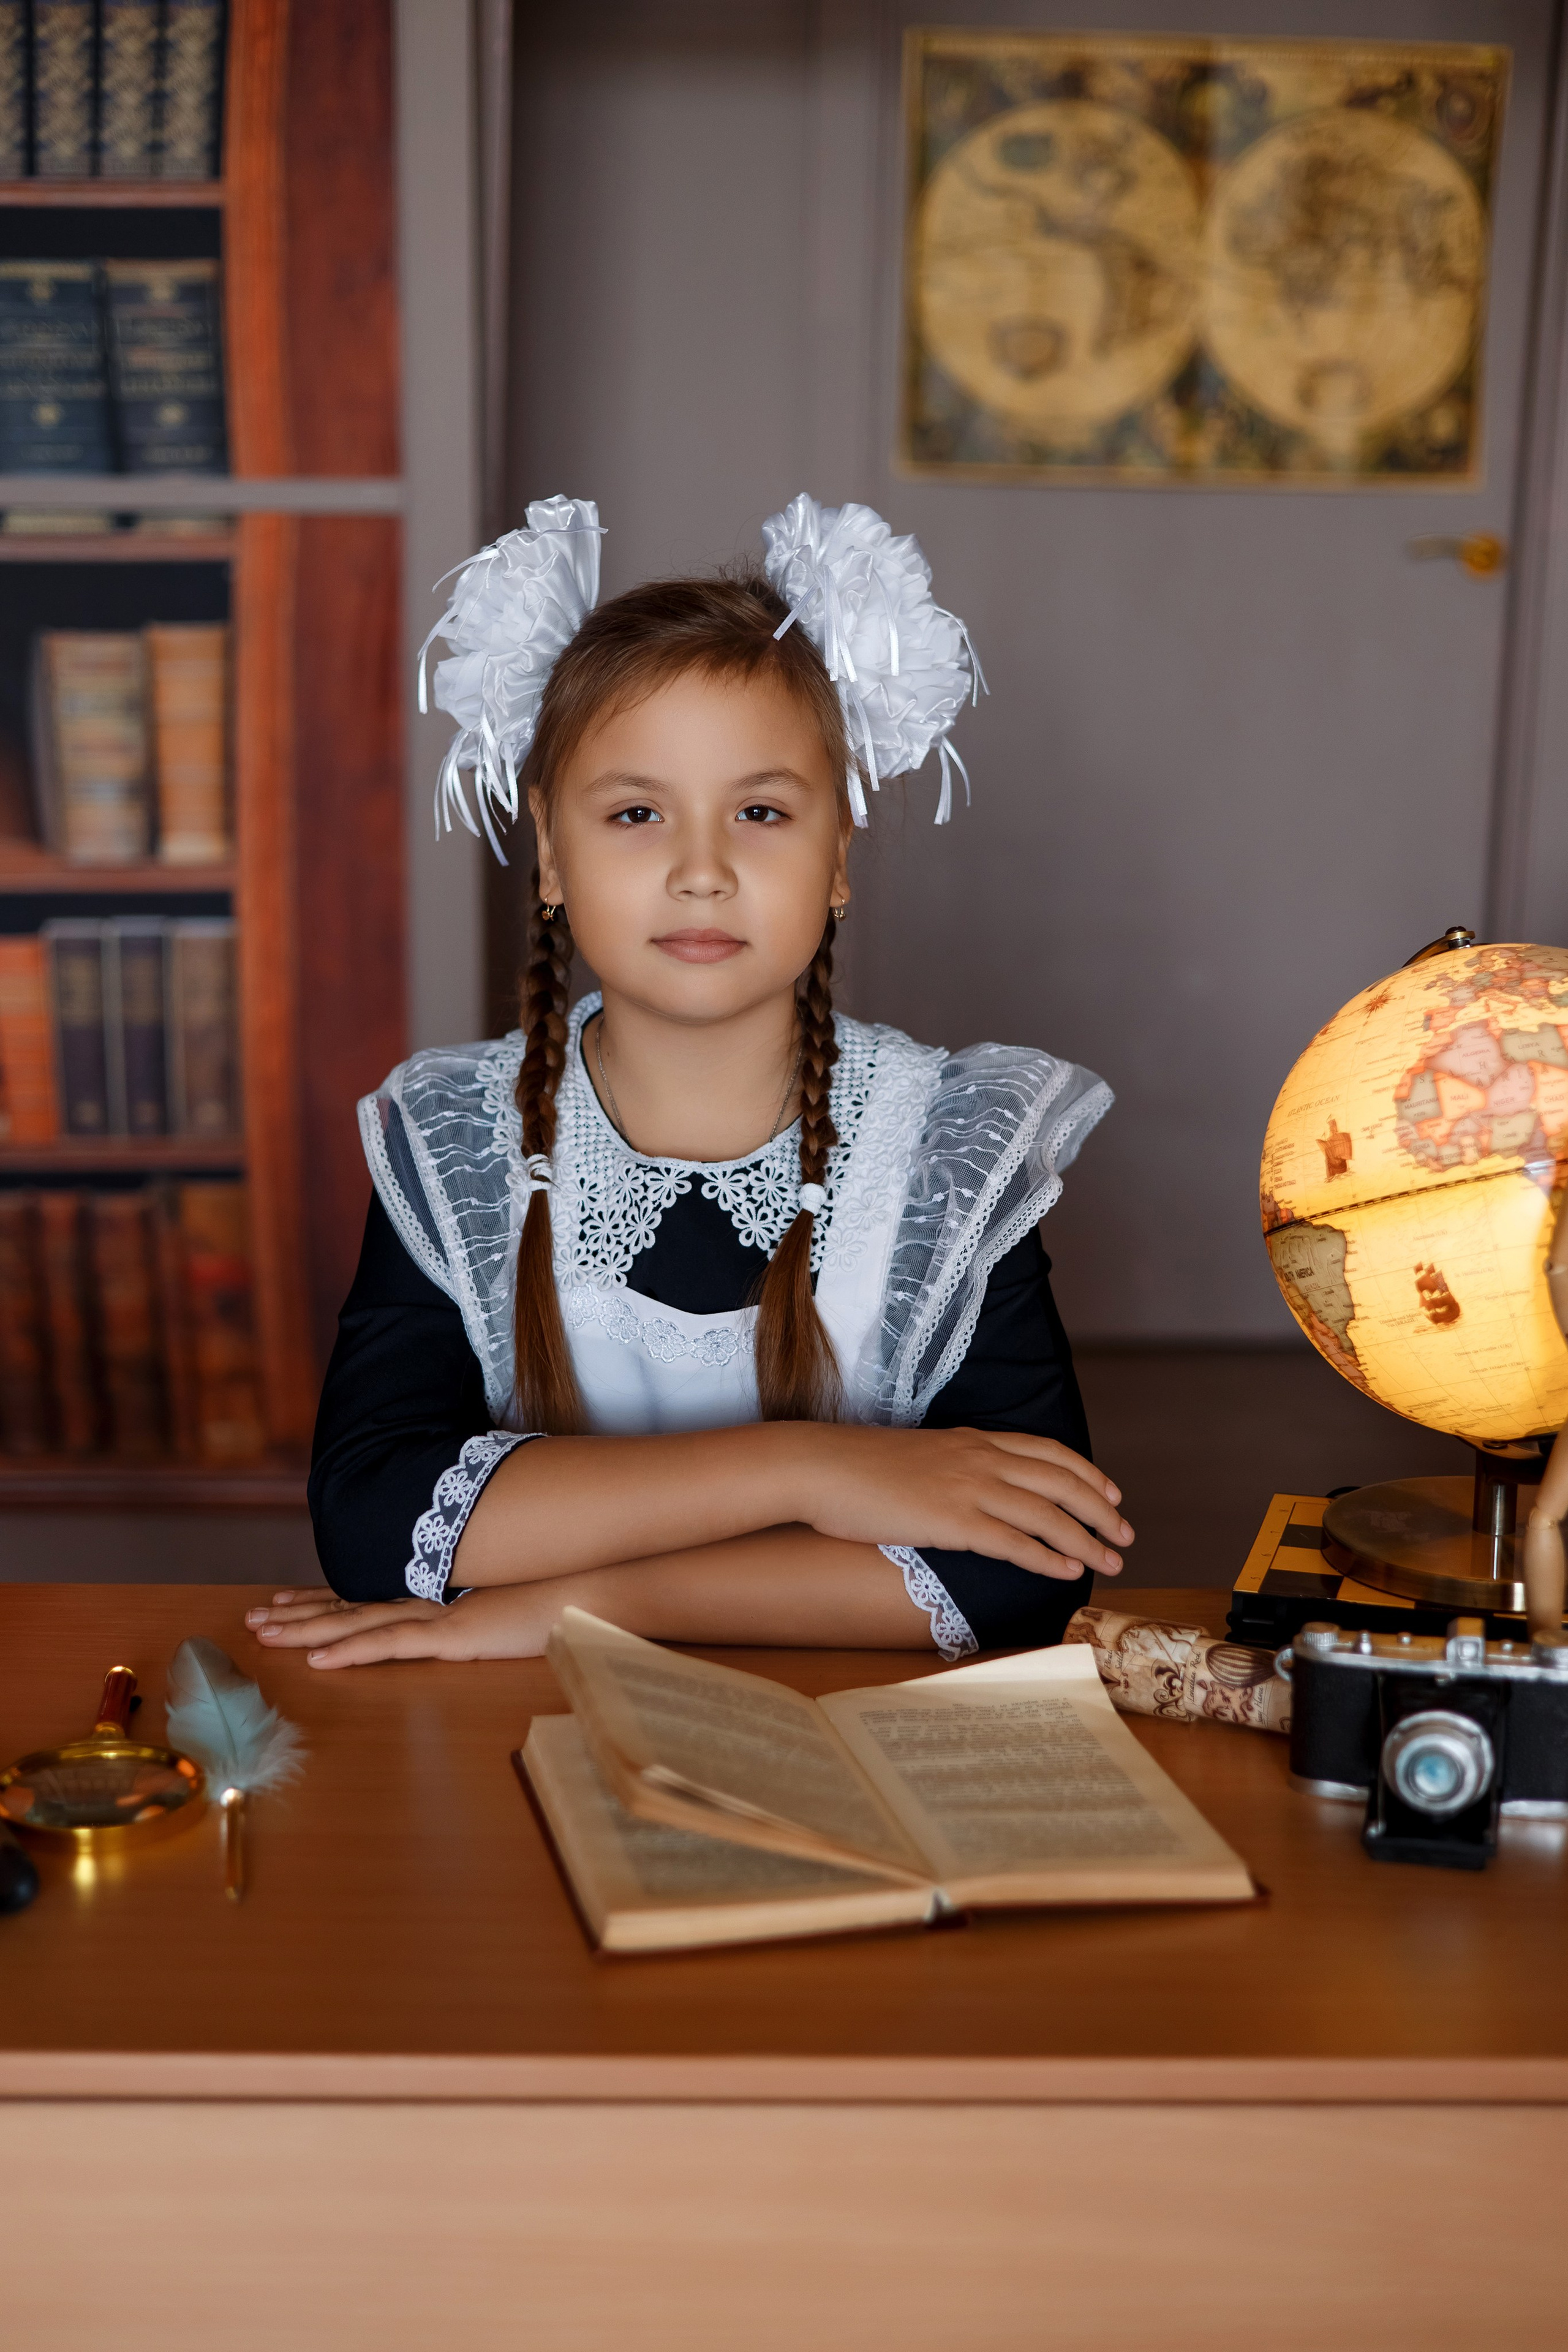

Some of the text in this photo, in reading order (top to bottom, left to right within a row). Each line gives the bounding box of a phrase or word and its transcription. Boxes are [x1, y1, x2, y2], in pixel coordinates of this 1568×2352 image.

[1518, 1041, 1540, 1050] LIBYA
[1461, 1048, 1491, 1058] ALGERIA
[1404, 1096, 1439, 1110] MAURITANIA
[1450, 1093, 1469, 1102] MALI
[1493, 1096, 1515, 1107] NIGER
[1544, 1094, 1565, 1104] CHAD
[1286, 1095, 1340, 1118] ATLANTIC OCEAN
[1295, 1266, 1315, 1279] AMERICA
[1189, 1649, 1201, 1669] Rock
[1253, 1686, 1264, 1709] Haven
